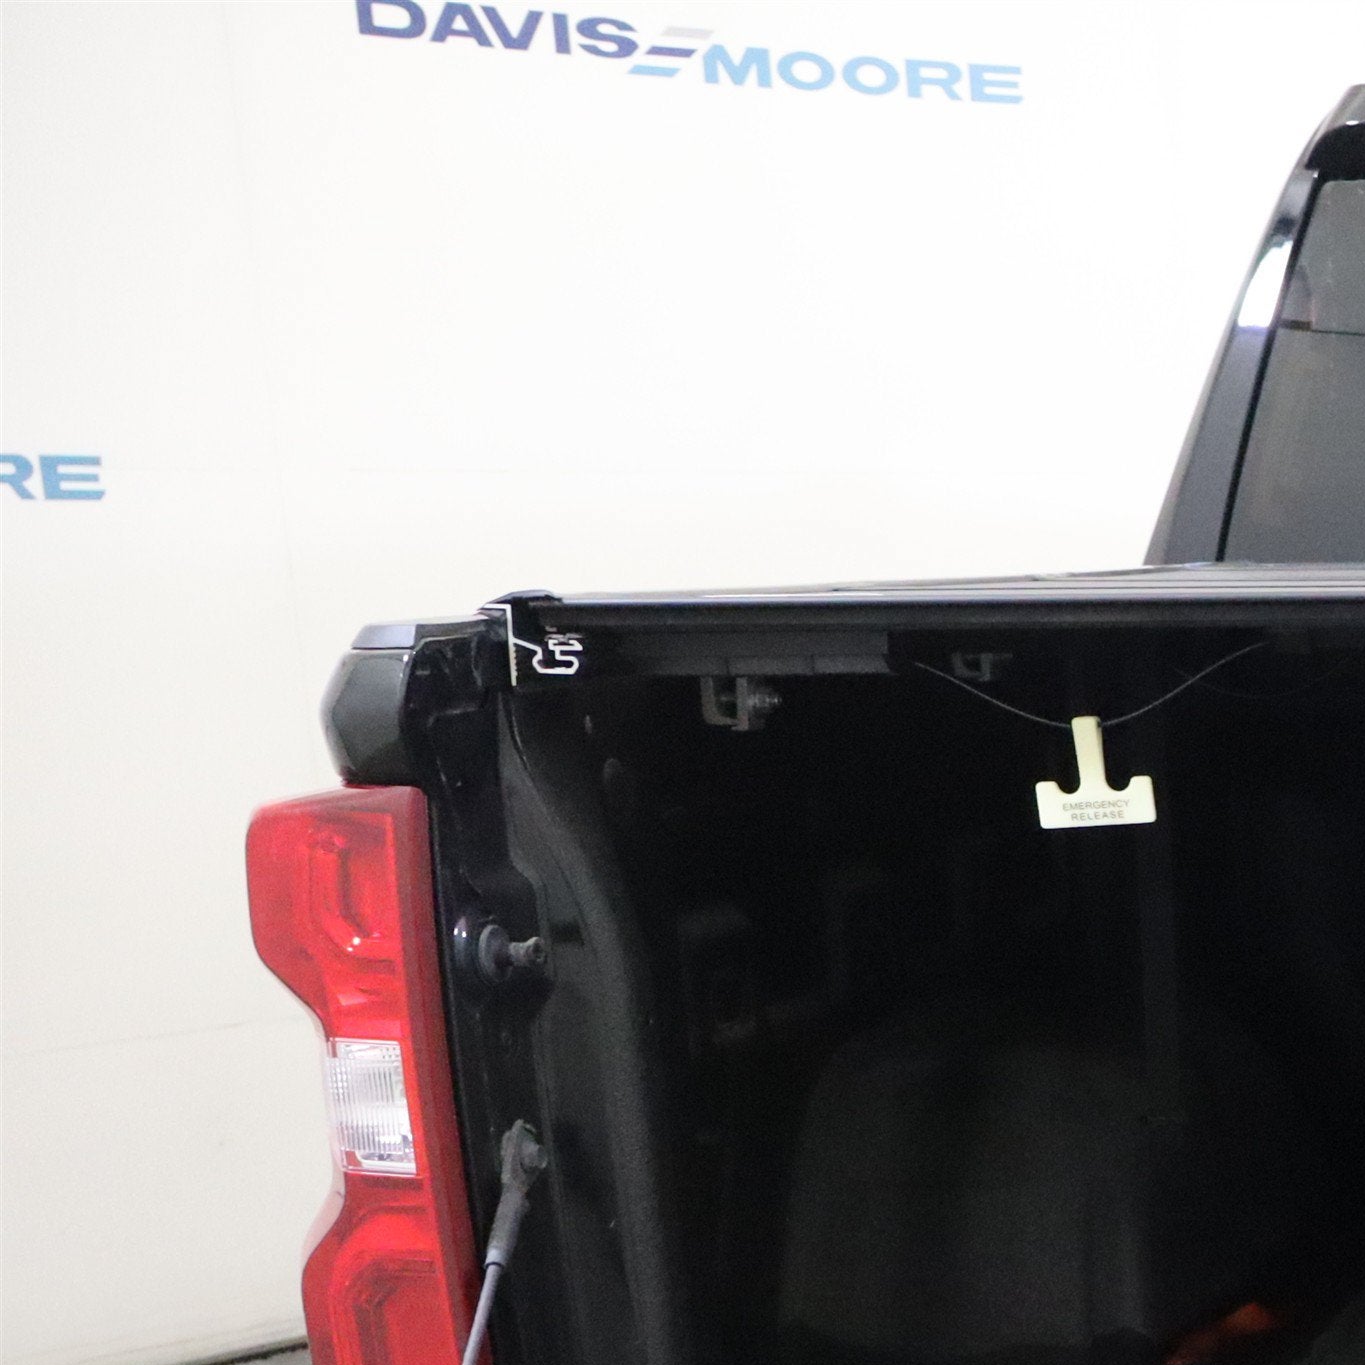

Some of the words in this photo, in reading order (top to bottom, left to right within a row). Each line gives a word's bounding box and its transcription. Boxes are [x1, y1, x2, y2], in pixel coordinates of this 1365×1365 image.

[356, 0, 639, 59] DAVIS
[702, 43, 1024, 104] MOORE
[1062, 799, 1130, 812] EMERGENCY
[1071, 810, 1125, 821] RELEASE
